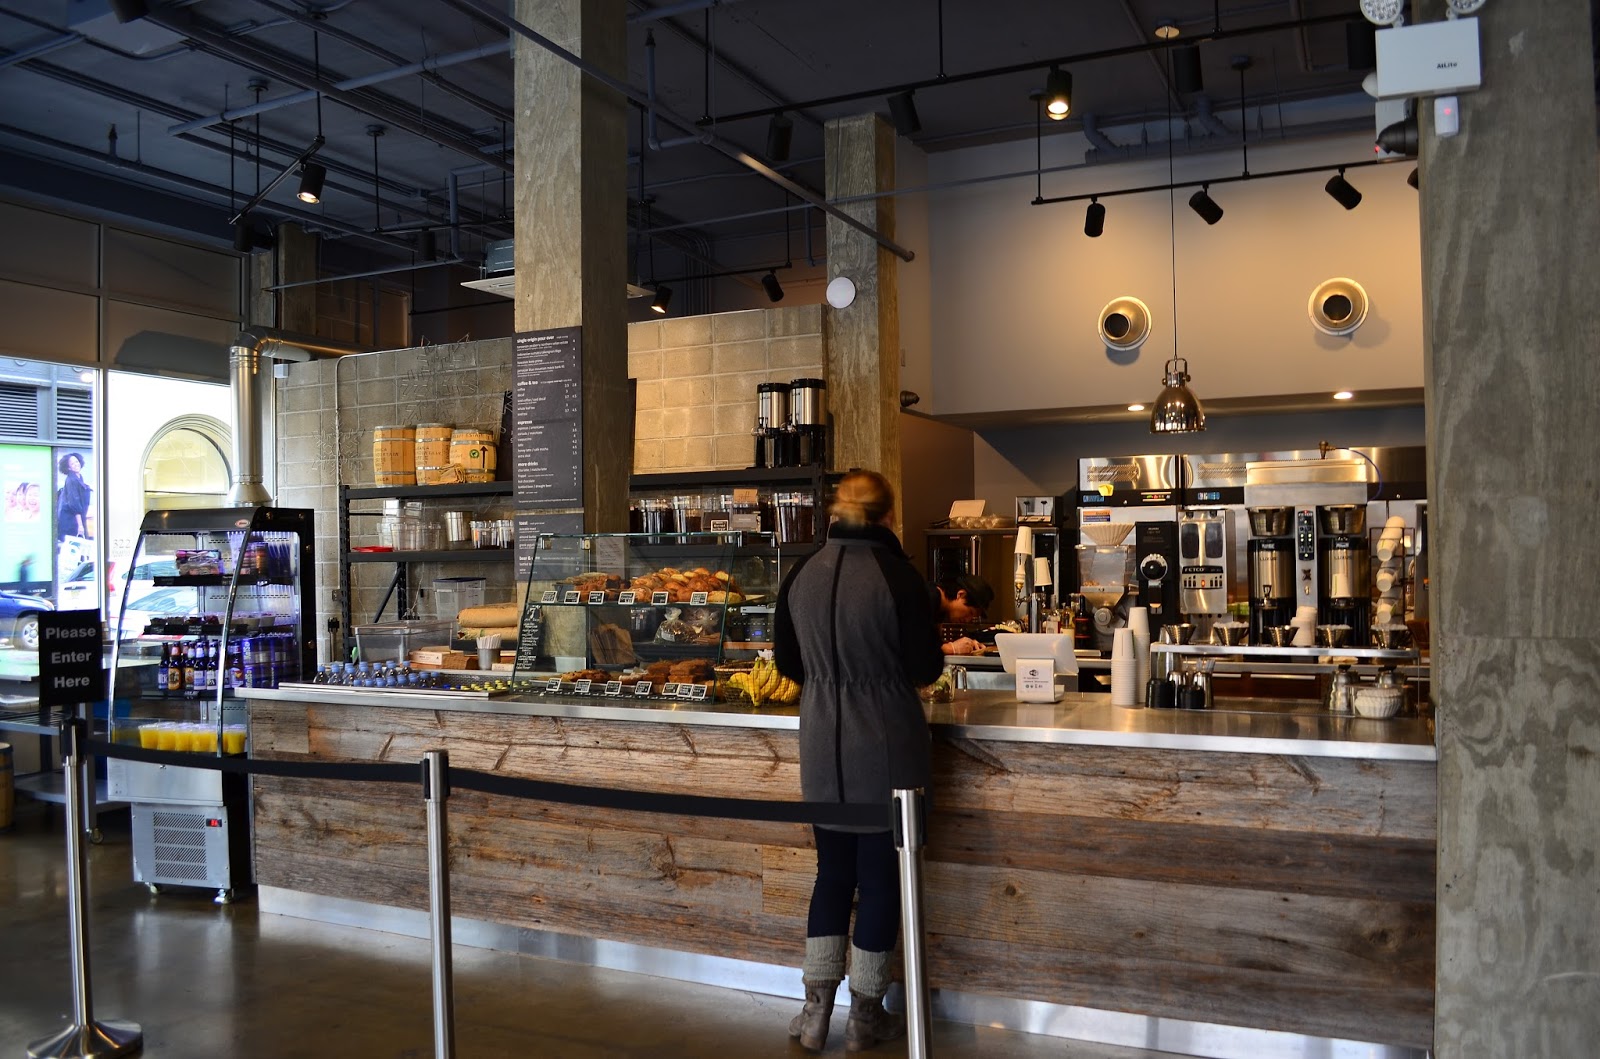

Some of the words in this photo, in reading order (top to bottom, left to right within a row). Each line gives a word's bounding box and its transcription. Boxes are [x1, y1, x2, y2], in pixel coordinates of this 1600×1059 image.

[45, 627, 97, 640] Please
[51, 651, 92, 664] Enter
[54, 676, 91, 689] Here
